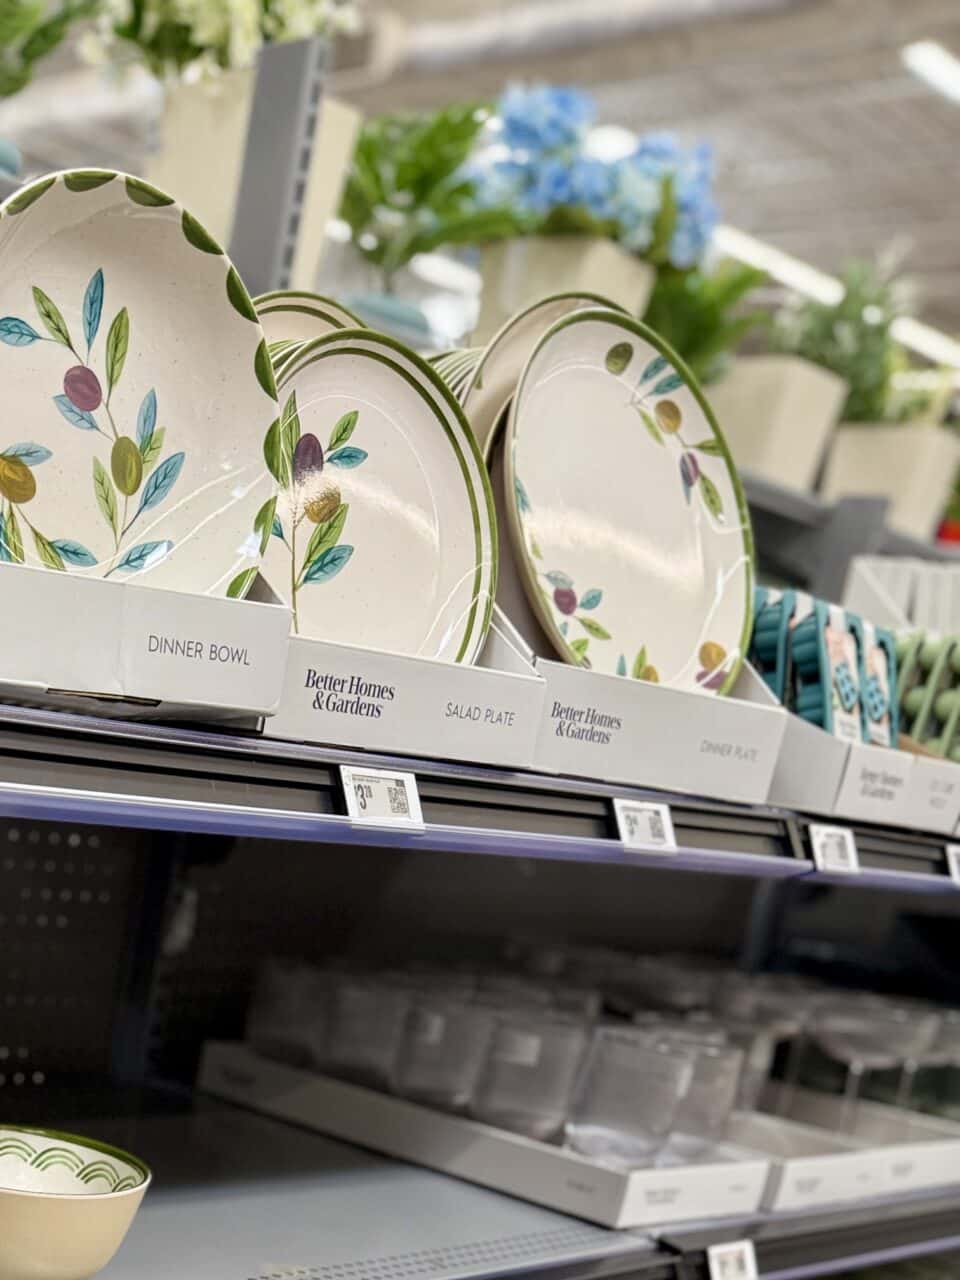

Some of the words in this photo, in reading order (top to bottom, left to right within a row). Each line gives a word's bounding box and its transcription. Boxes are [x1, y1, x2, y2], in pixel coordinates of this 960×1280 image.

[148, 634, 204, 659] DINNER
[209, 644, 250, 666] BOWL
[304, 668, 348, 693] Better
[349, 675, 396, 700] Homes
[445, 702, 481, 721] SALAD
[484, 708, 516, 727] PLATE
[551, 701, 585, 722] Better
[585, 707, 622, 729] Homes
